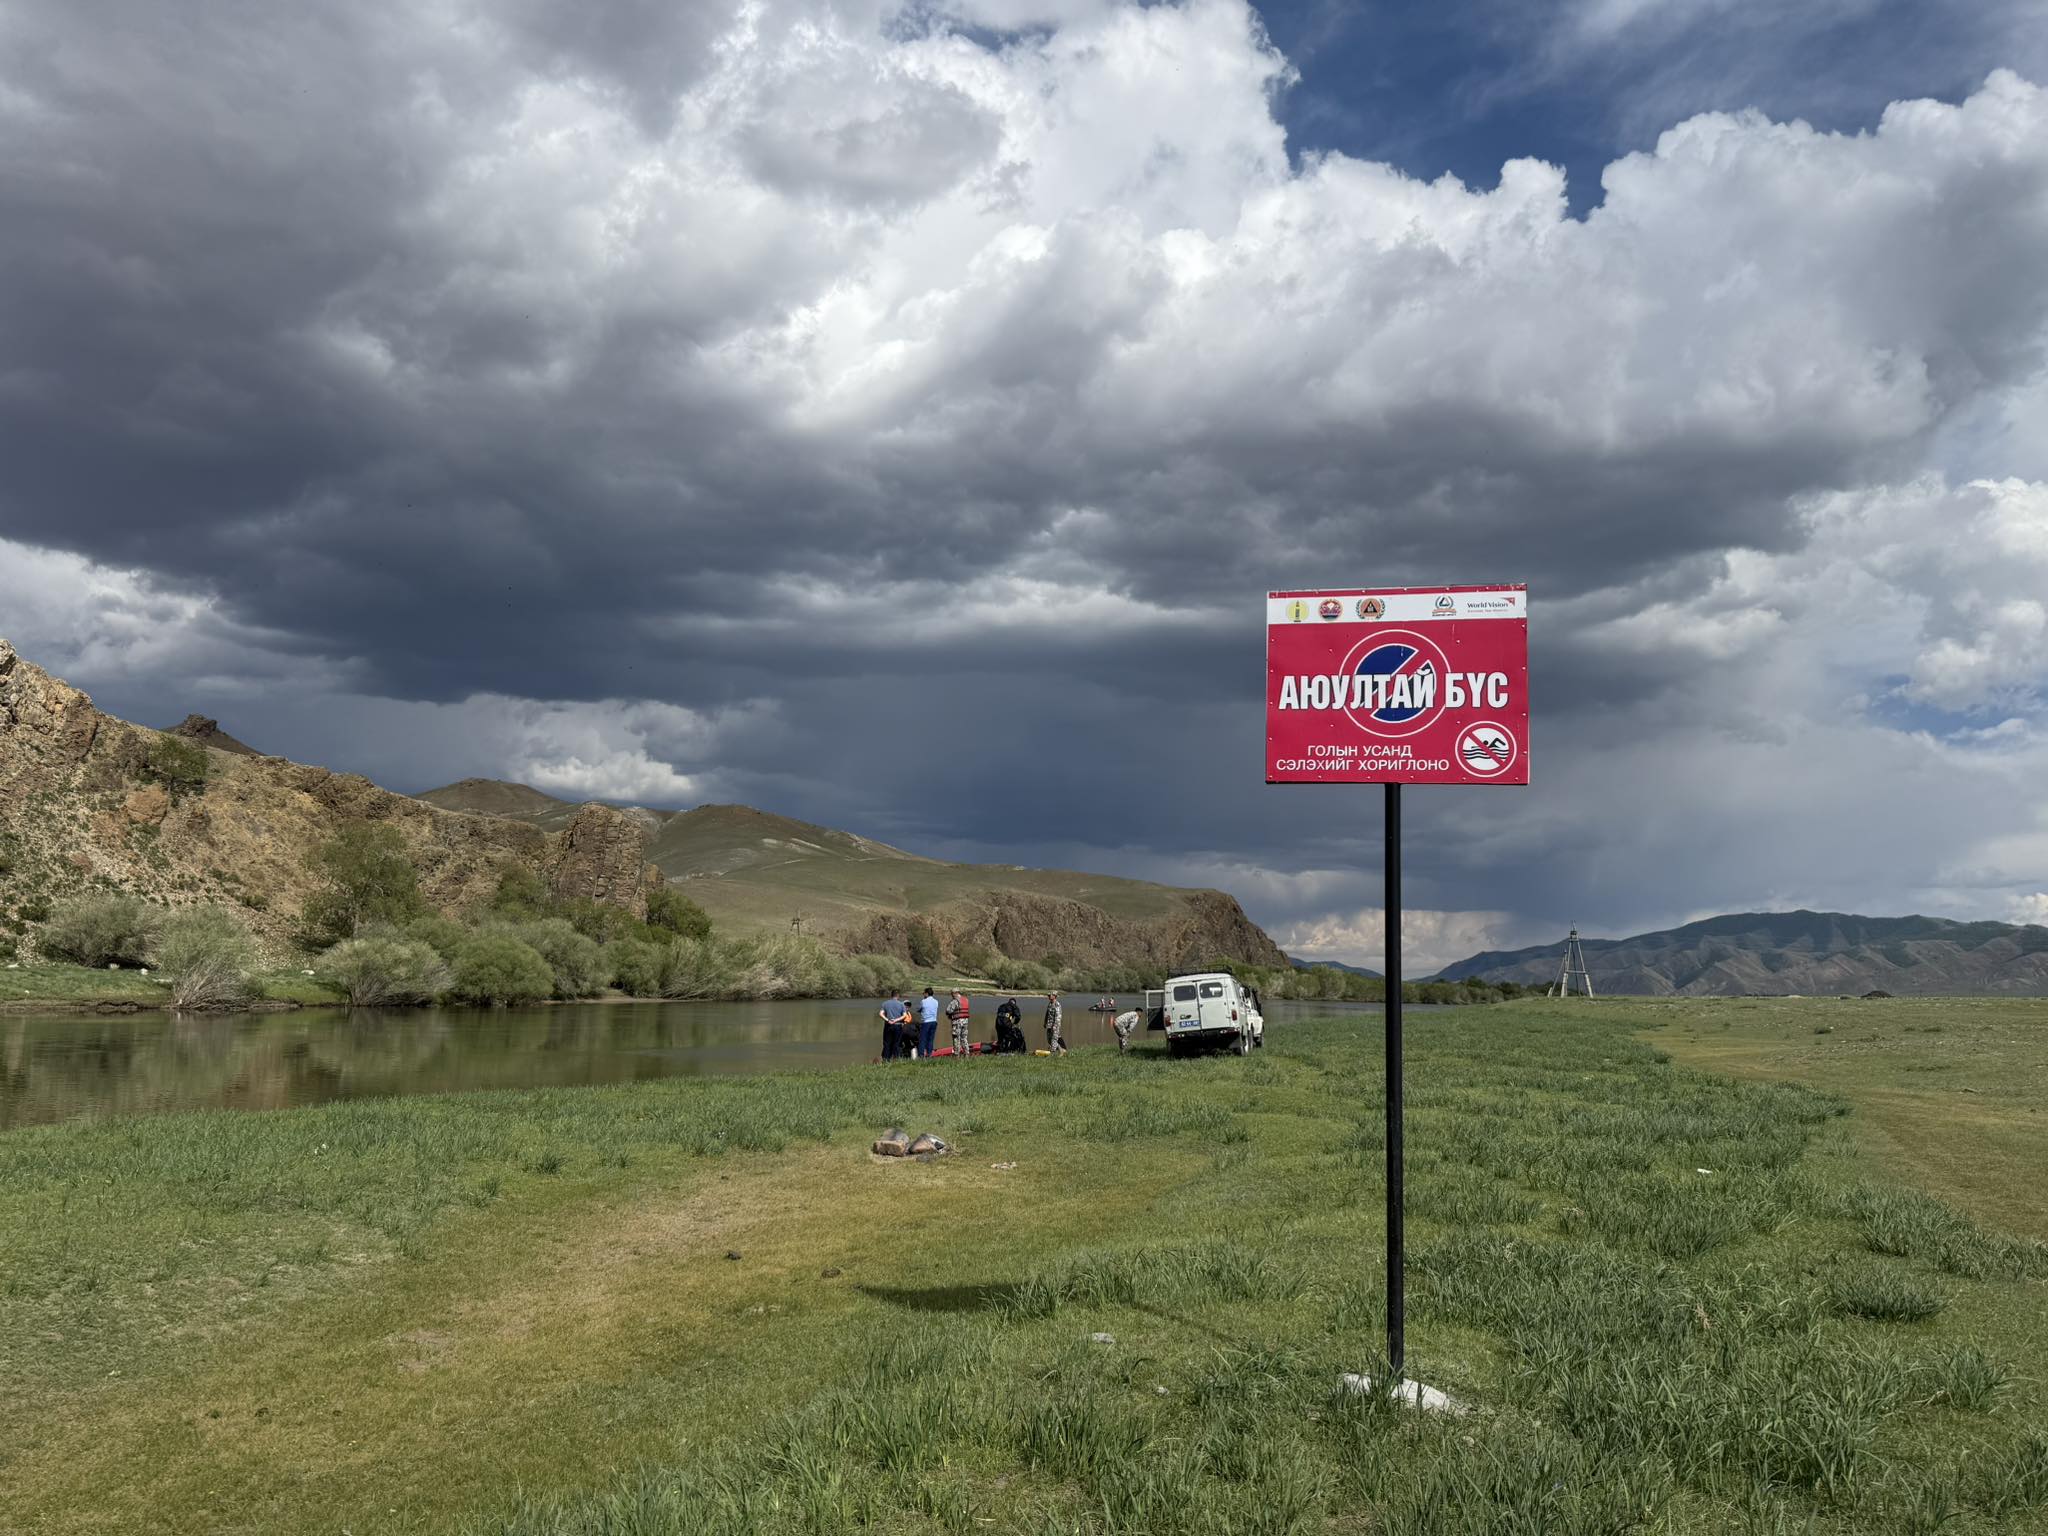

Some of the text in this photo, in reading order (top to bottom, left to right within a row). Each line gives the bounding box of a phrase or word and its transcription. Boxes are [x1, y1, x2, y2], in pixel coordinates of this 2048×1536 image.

[1278, 667, 1509, 710] АЮУЛТАЙ БҮС
[1307, 745, 1413, 758] ГОЛЫН УСАНД
[1276, 758, 1450, 771] СЭЛЭХИЙГ ХОРИГЛОНО
